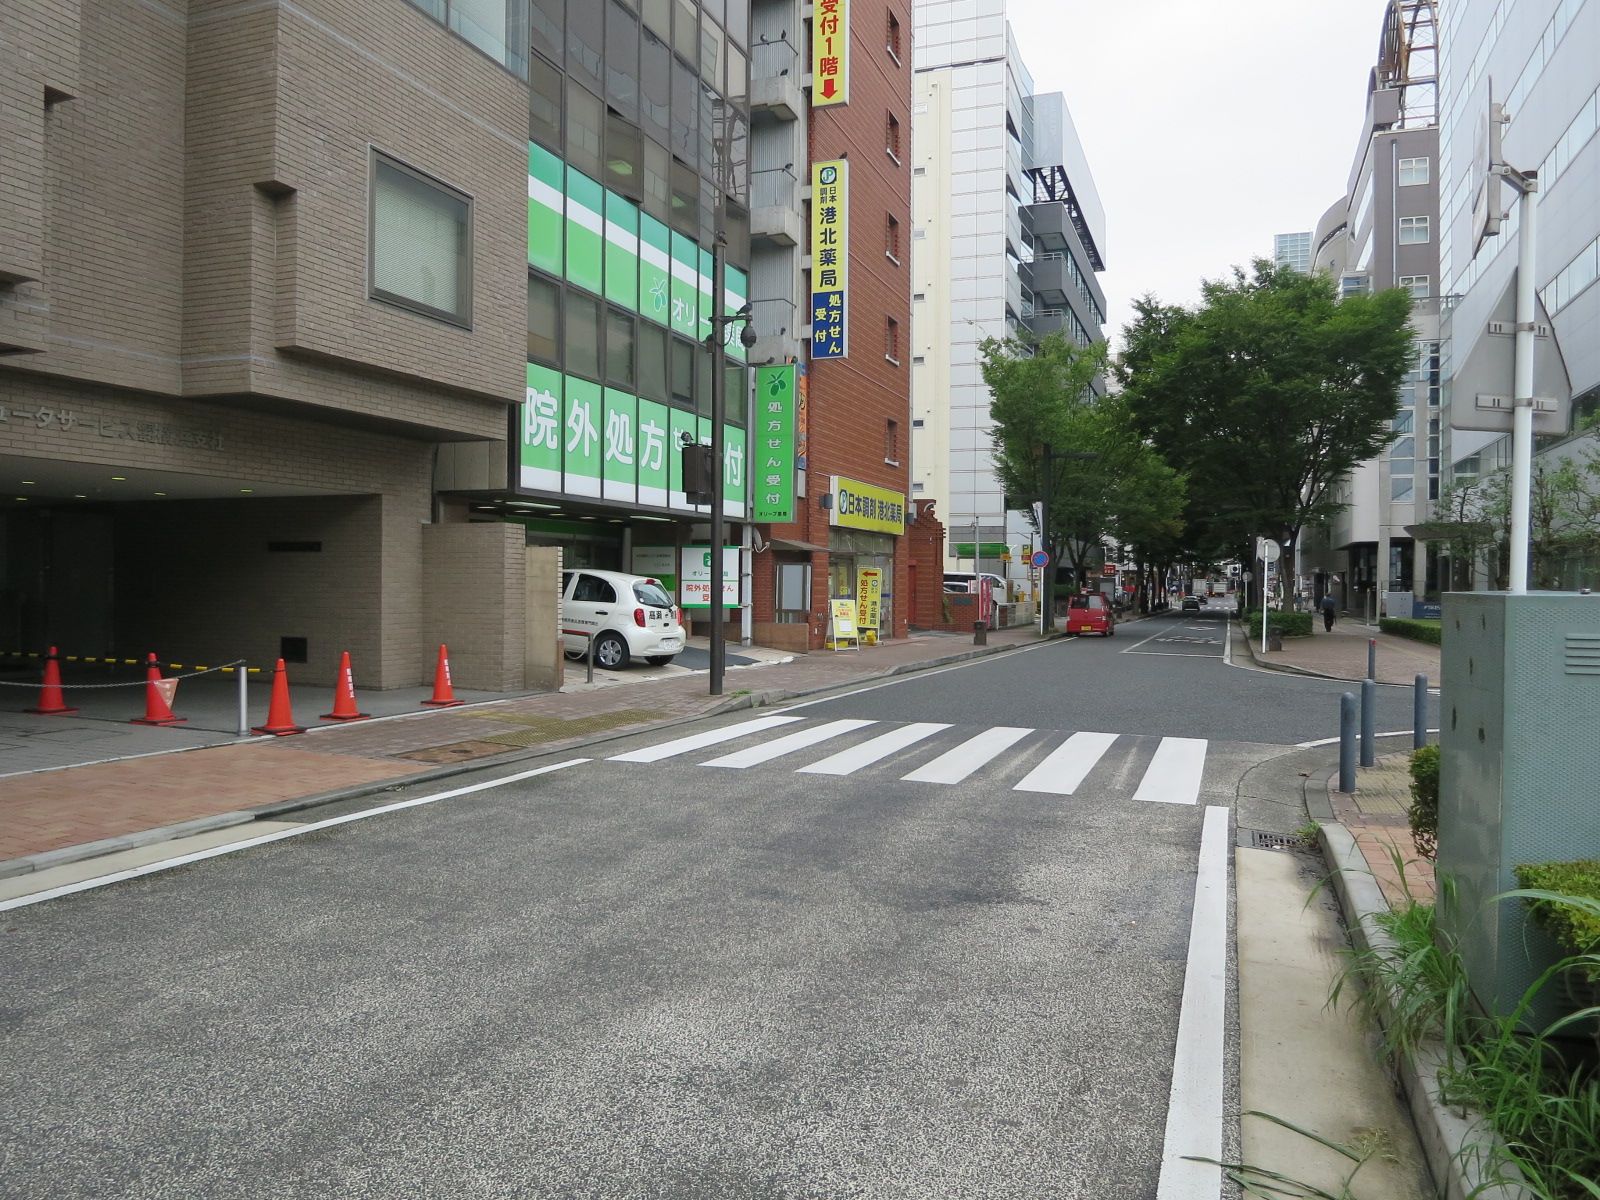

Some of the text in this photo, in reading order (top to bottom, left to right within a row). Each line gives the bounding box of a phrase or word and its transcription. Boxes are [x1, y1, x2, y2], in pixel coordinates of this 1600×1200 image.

[820, 207, 837, 288] 港北薬局
[815, 308, 827, 344] 受付
[829, 294, 842, 354] 処方せん
[766, 401, 783, 505] 処方せん受付
